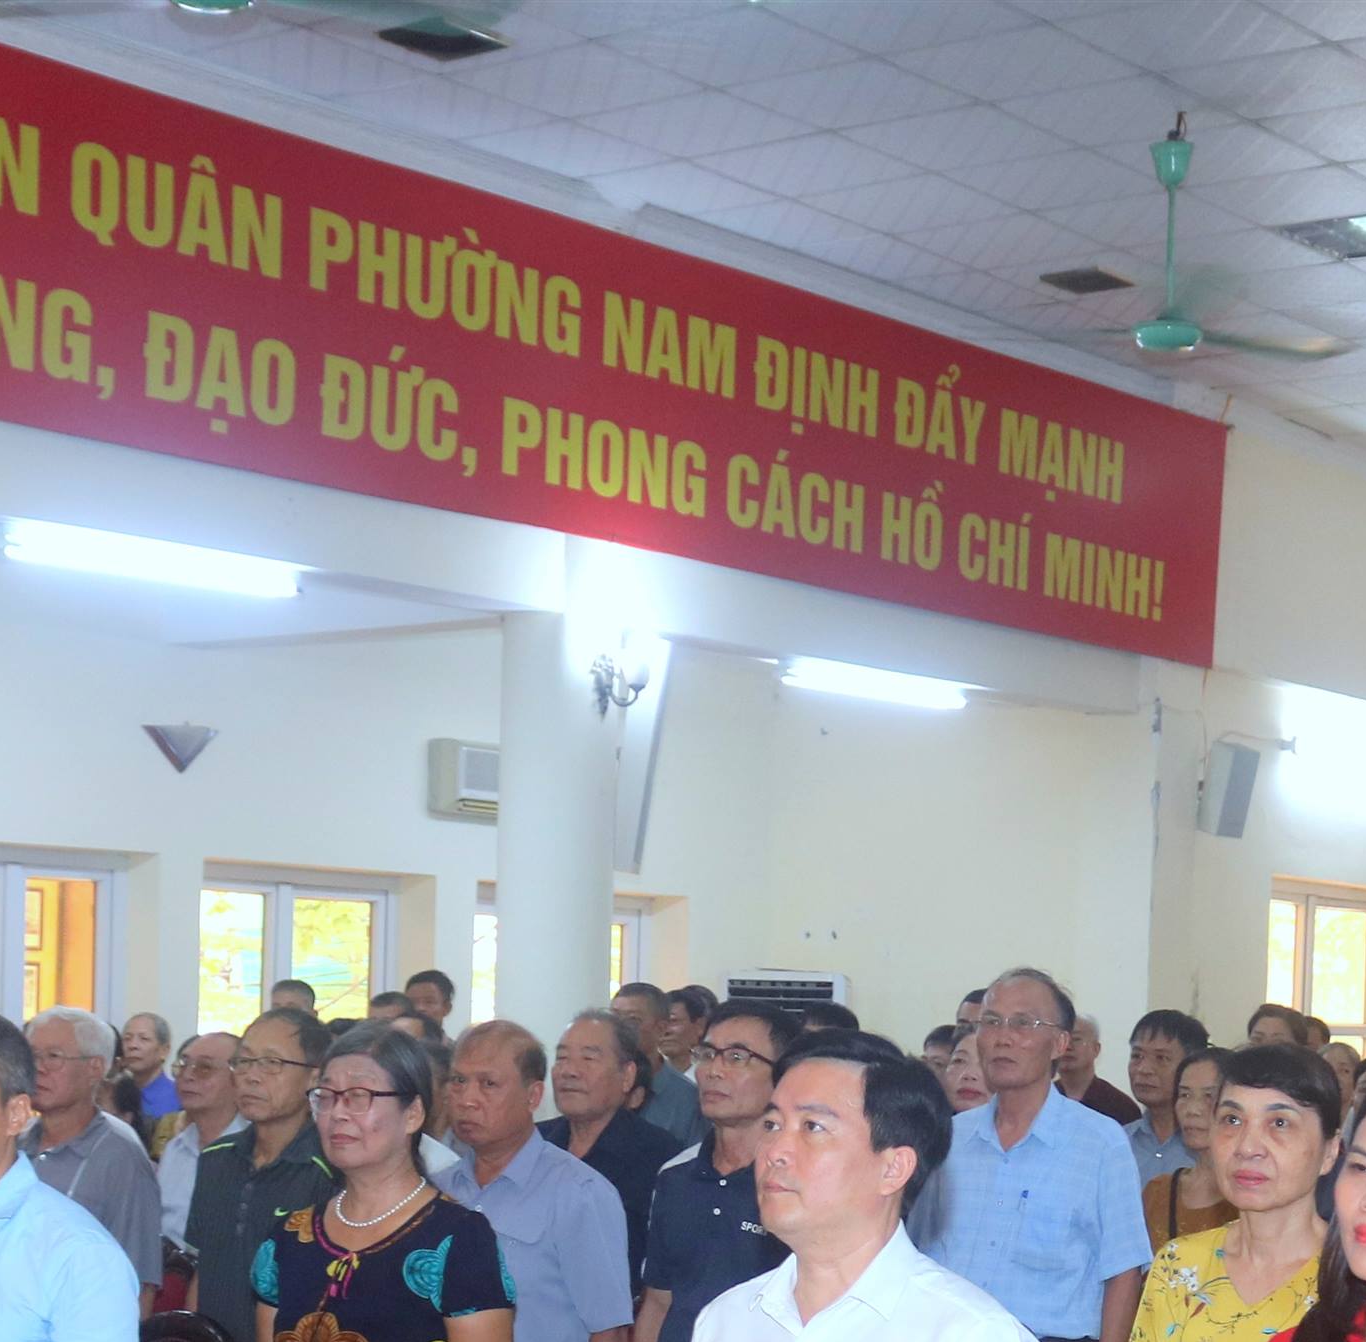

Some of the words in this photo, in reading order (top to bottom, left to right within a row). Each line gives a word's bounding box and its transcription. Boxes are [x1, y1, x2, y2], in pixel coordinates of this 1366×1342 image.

[70, 141, 282, 279] QUÂN
[308, 206, 582, 359] PHƯỜNG
[602, 290, 736, 399] NAM
[754, 335, 880, 438] ĐỊNH
[893, 363, 987, 466] ĐẨY
[998, 407, 1125, 505] MẠNH
[143, 309, 297, 435] ĐẠO
[319, 344, 478, 478] ĐỨC,
[501, 396, 707, 518] PHONG
[725, 448, 865, 555] CÁCH
[880, 480, 944, 571] HỒ
[957, 511, 1033, 592] CHÍ
[1042, 532, 1166, 622] MINH!
[740, 1221, 768, 1236] SPOR
